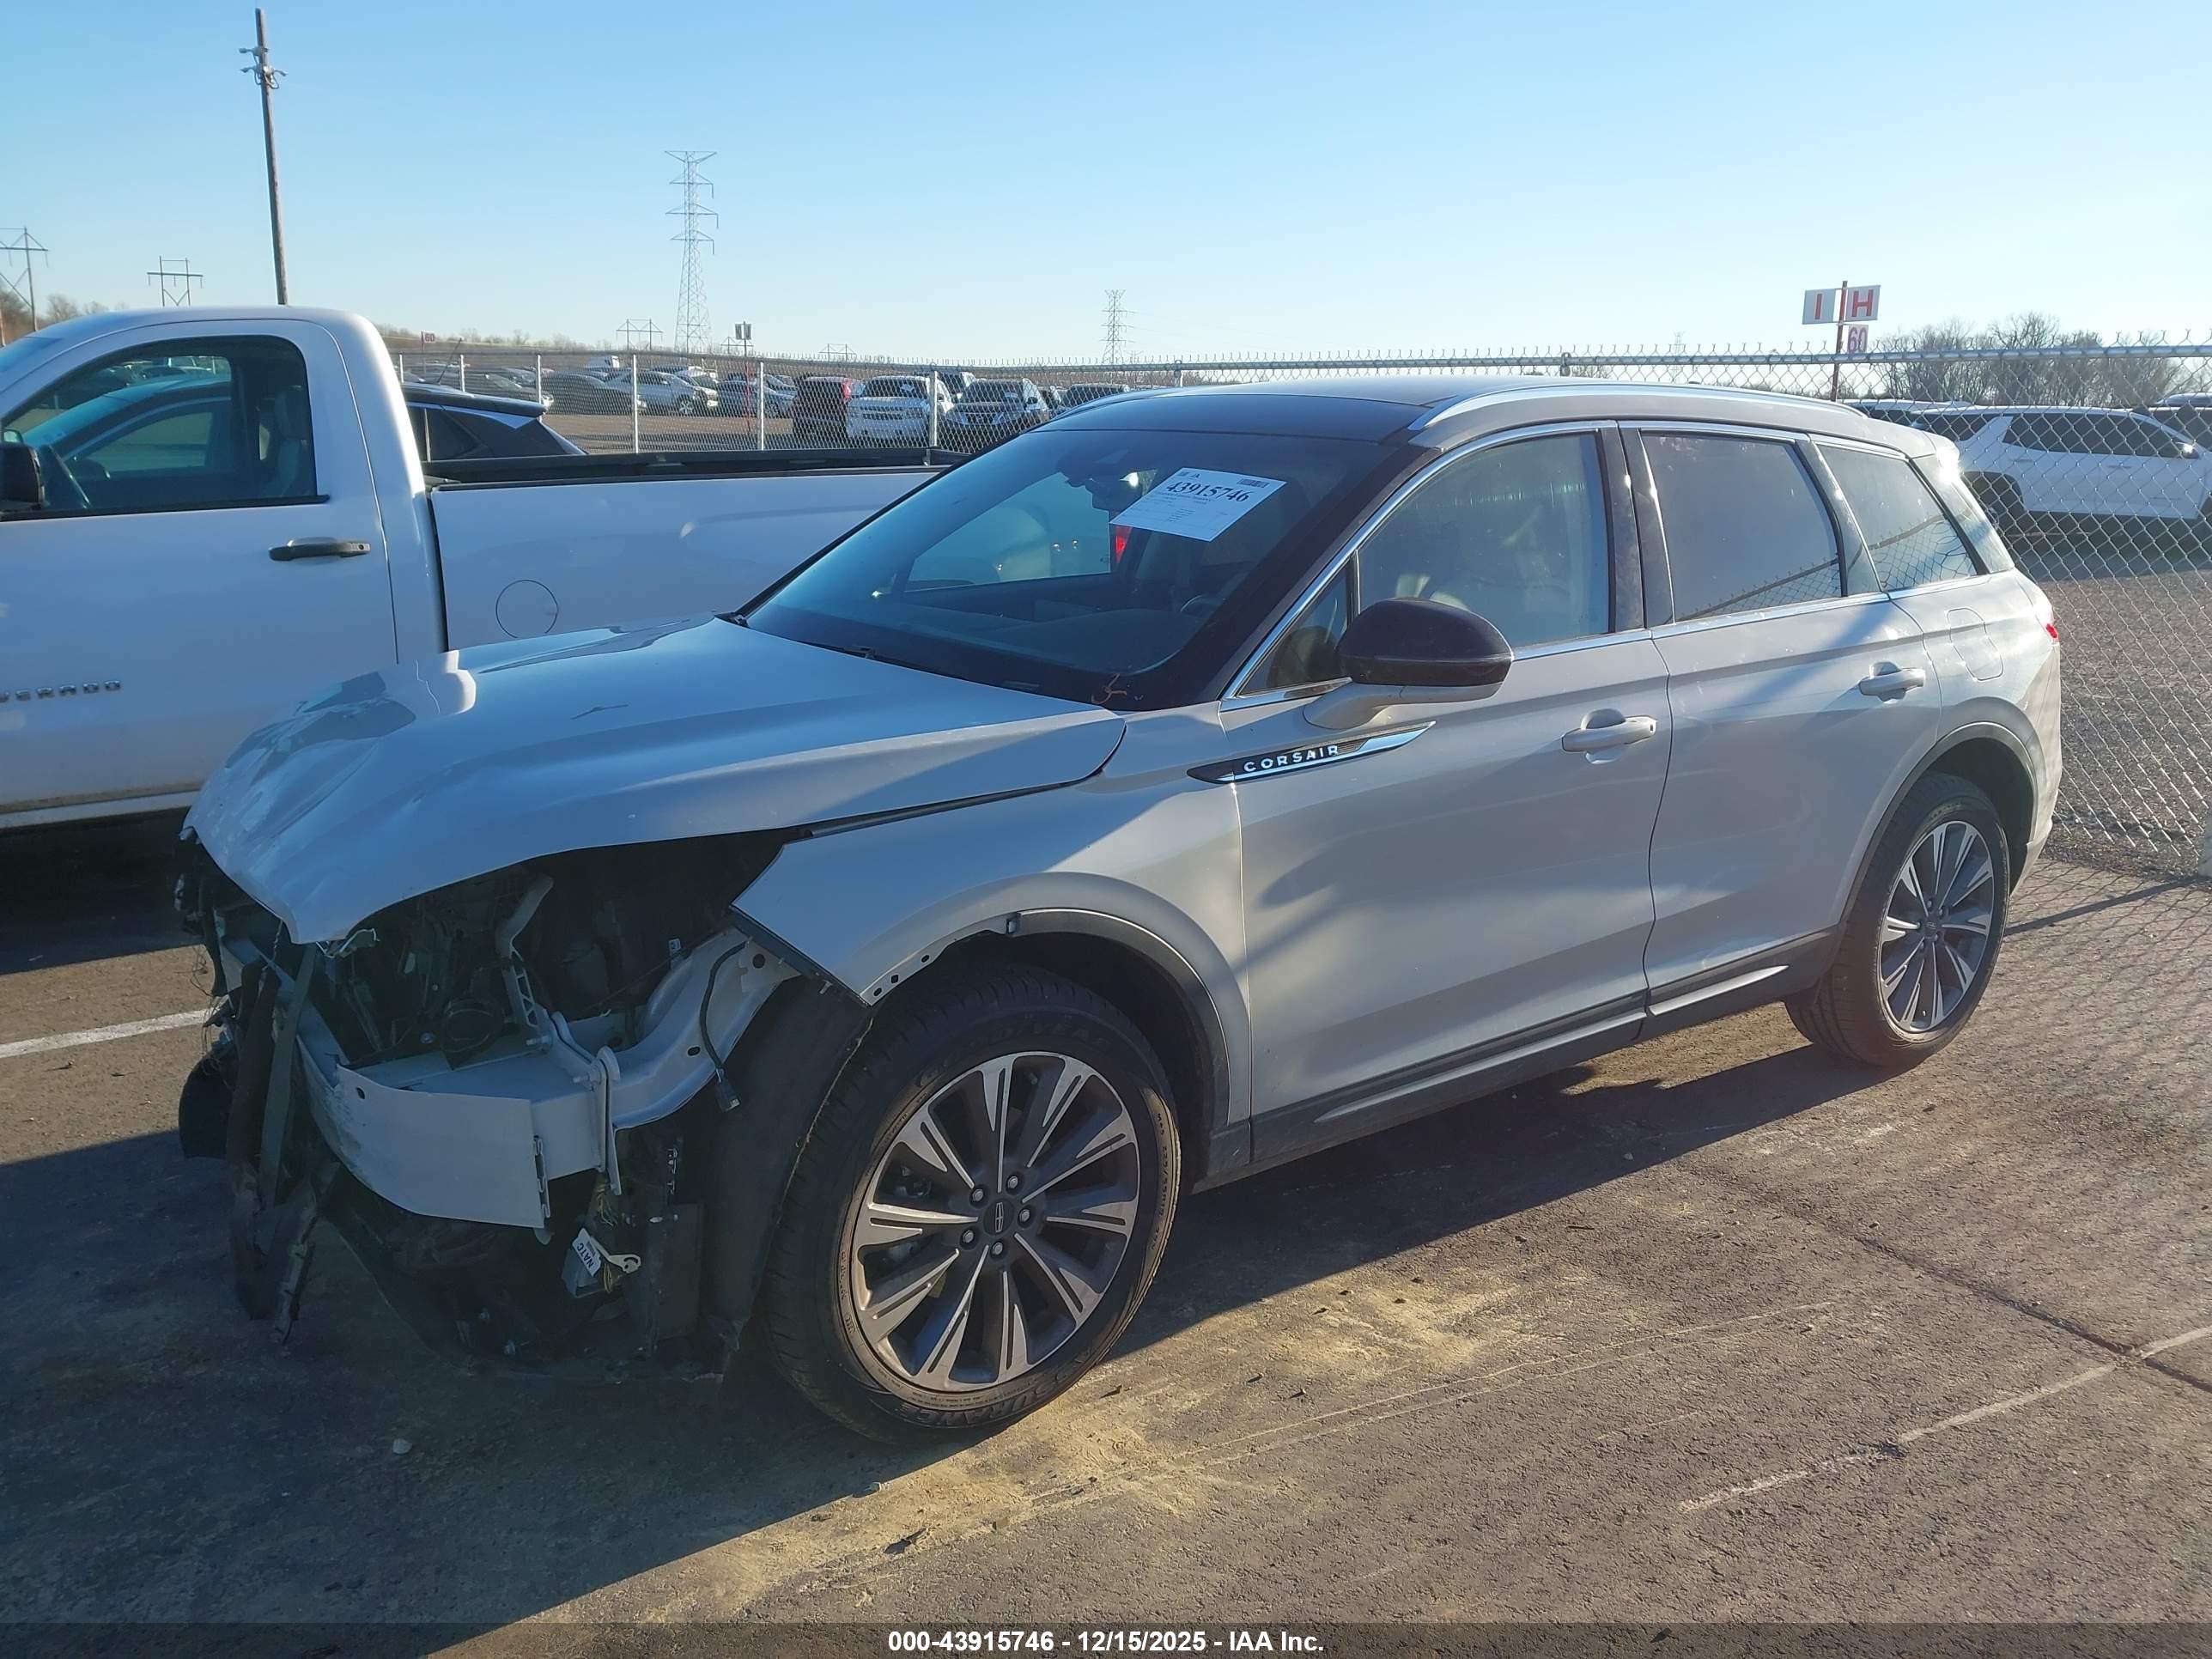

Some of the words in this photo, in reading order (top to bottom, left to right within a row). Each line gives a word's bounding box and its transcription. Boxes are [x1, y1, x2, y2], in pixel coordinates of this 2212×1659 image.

[1814, 293, 1823, 319] I
[1851, 289, 1874, 317] H
[1847, 326, 1868, 353] 60
[1165, 481, 1255, 502] 43915746
[1243, 744, 1340, 773] CORSAIR
[576, 1243, 594, 1268] NATC
